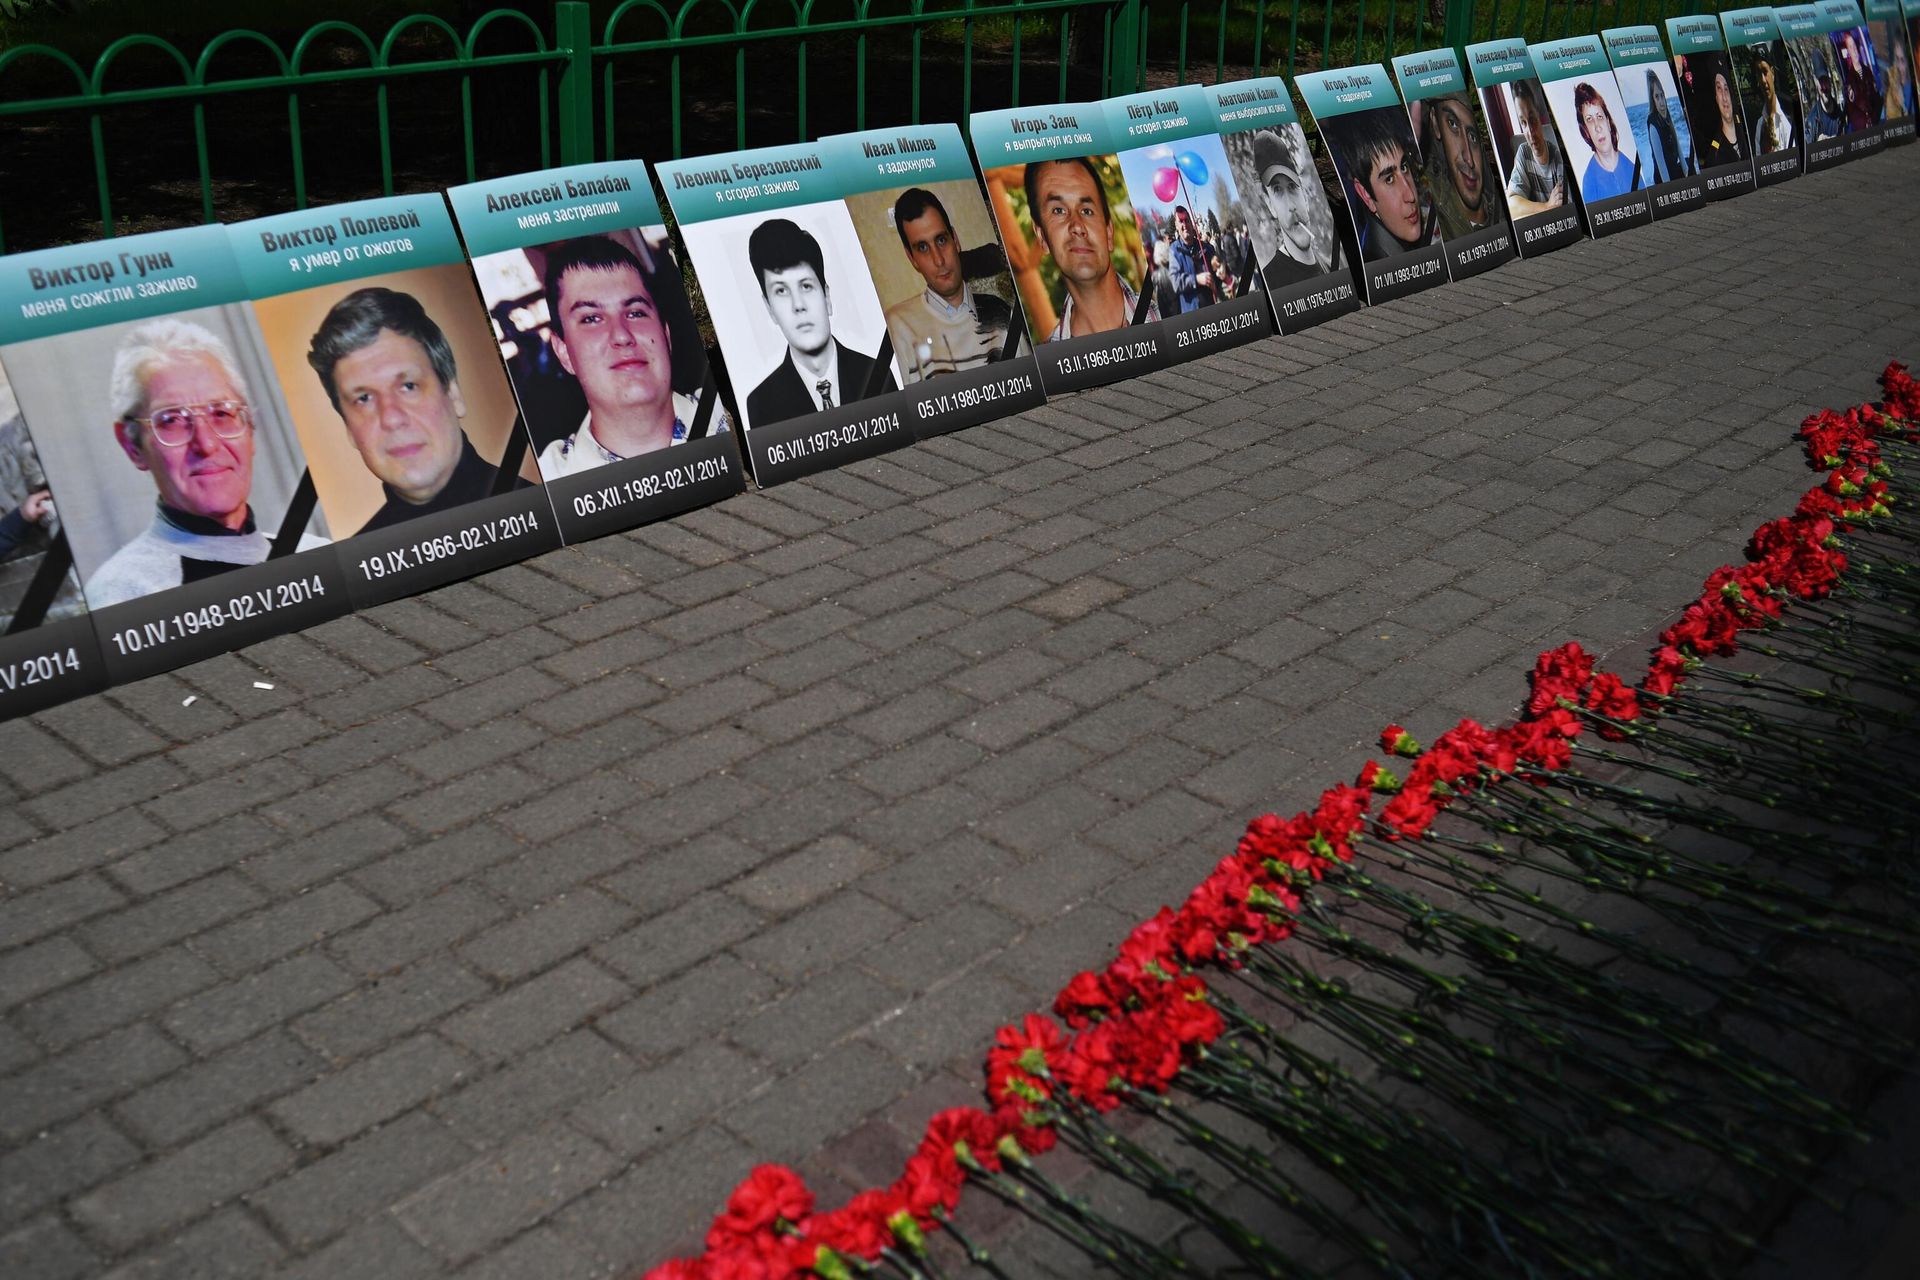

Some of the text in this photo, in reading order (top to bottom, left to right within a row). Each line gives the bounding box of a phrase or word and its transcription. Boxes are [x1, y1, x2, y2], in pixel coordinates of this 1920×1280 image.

[1475, 50, 1508, 64] Александр
[1542, 50, 1560, 61] Анна
[1607, 36, 1634, 50] Кристина
[1403, 61, 1429, 76] Евгений
[1217, 88, 1279, 108] Анатолий Калин
[1322, 76, 1372, 92] Игорь Лукас
[1010, 114, 1078, 134] Игорь Заяц
[1126, 100, 1180, 120] Пётр Каир
[1220, 104, 1286, 122] меня выбросили из окна
[1128, 116, 1188, 136] я сгорел заживо
[862, 137, 936, 158] Иван Милев
[1004, 132, 1093, 152] я выпрыгнул из окна
[672, 154, 822, 190] Леонид Березовский
[878, 158, 936, 174] я задохнулся
[486, 175, 632, 213] Алексей Балабан
[716, 180, 800, 203] я сгорел заживо
[517, 200, 620, 230] меня застрелили
[260, 209, 421, 252] Виктор Полевой
[289, 238, 414, 272] я умер от ожогов
[28, 252, 174, 290] Виктор Гунн
[20, 275, 198, 319] меня сожгли заживо
[1283, 284, 1353, 318] 12.VIII.1976-02.V.2014
[1176, 310, 1260, 348] 28.I.1969-02.V.2014
[1056, 340, 1158, 376] 13.II.1968-02.V.2014
[918, 375, 1032, 419] 05.VI.1980-02.V.2014
[768, 412, 900, 465] 06.VII.1973-02.V.2014
[573, 456, 729, 517] 06.XII.1982-02.V.2014
[358, 510, 539, 581] 19.IX.1966-02.V.2014
[112, 575, 324, 655] 10.IV.1948-02.V.2014
